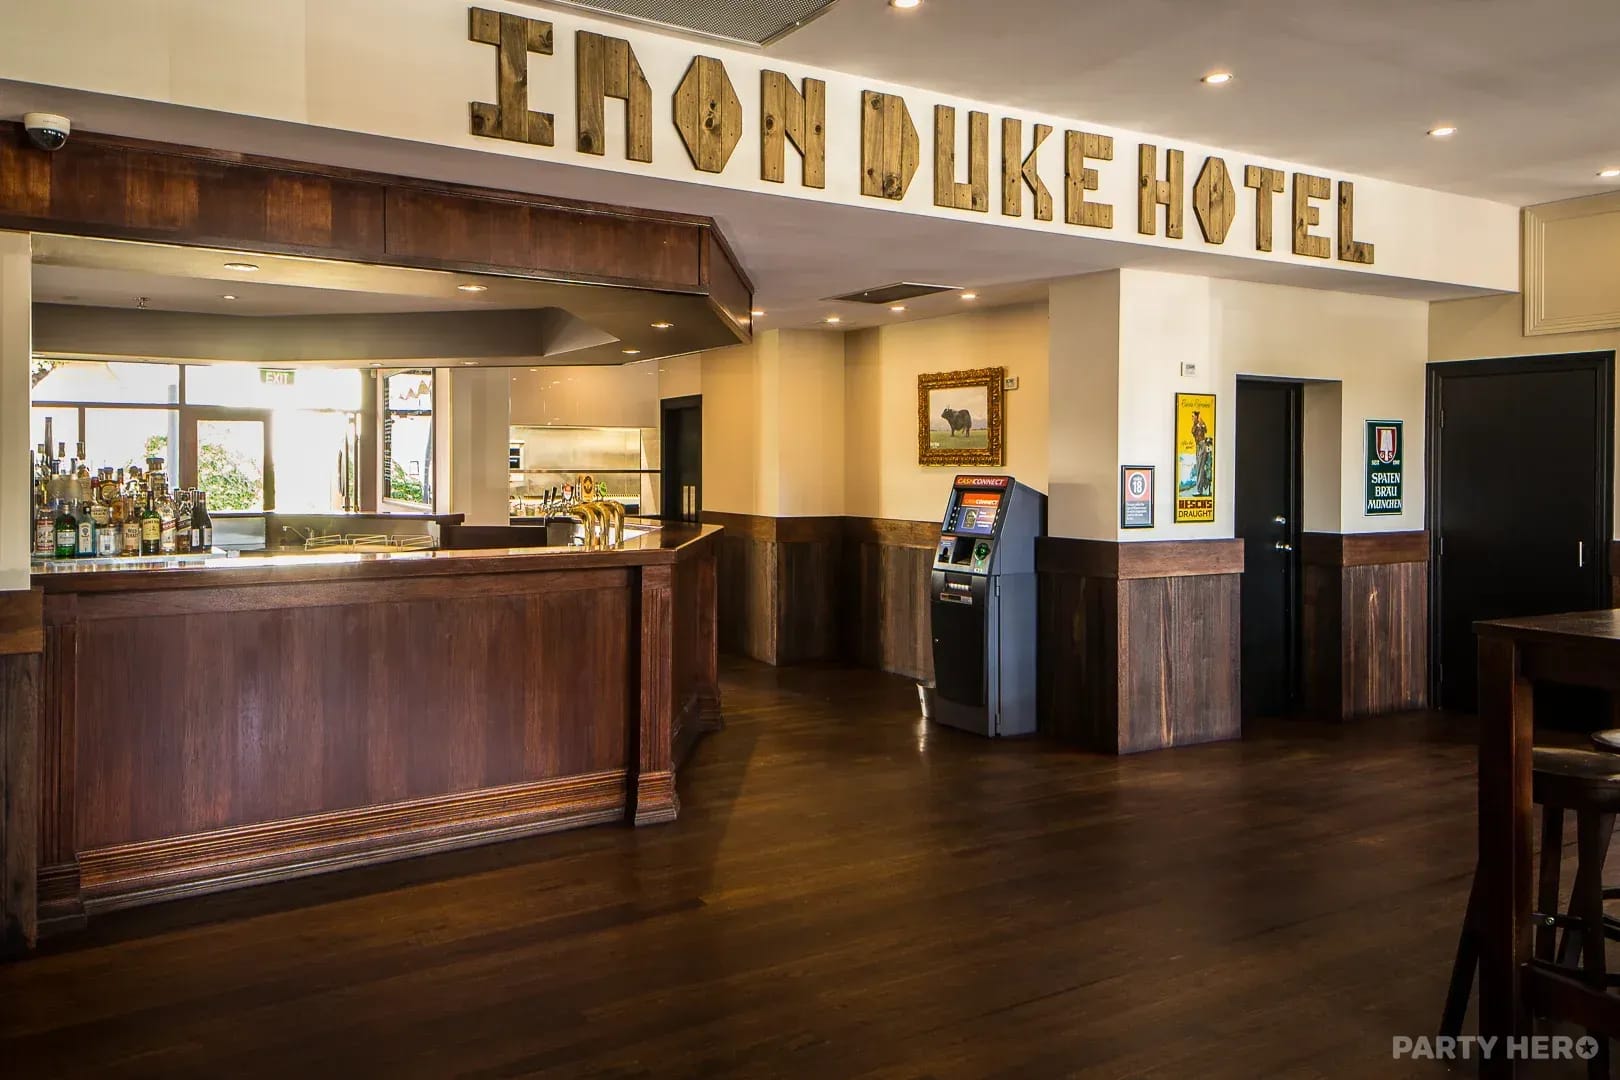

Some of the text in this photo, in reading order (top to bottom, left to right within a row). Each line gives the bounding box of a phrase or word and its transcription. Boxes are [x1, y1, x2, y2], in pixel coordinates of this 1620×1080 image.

[469, 6, 1375, 265] IRON DUKE HOTEL
[265, 371, 289, 384] EXIT
[1371, 472, 1401, 484] SPATEN
[1132, 480, 1143, 493] 18
[1178, 510, 1213, 518] DRAUGHT
